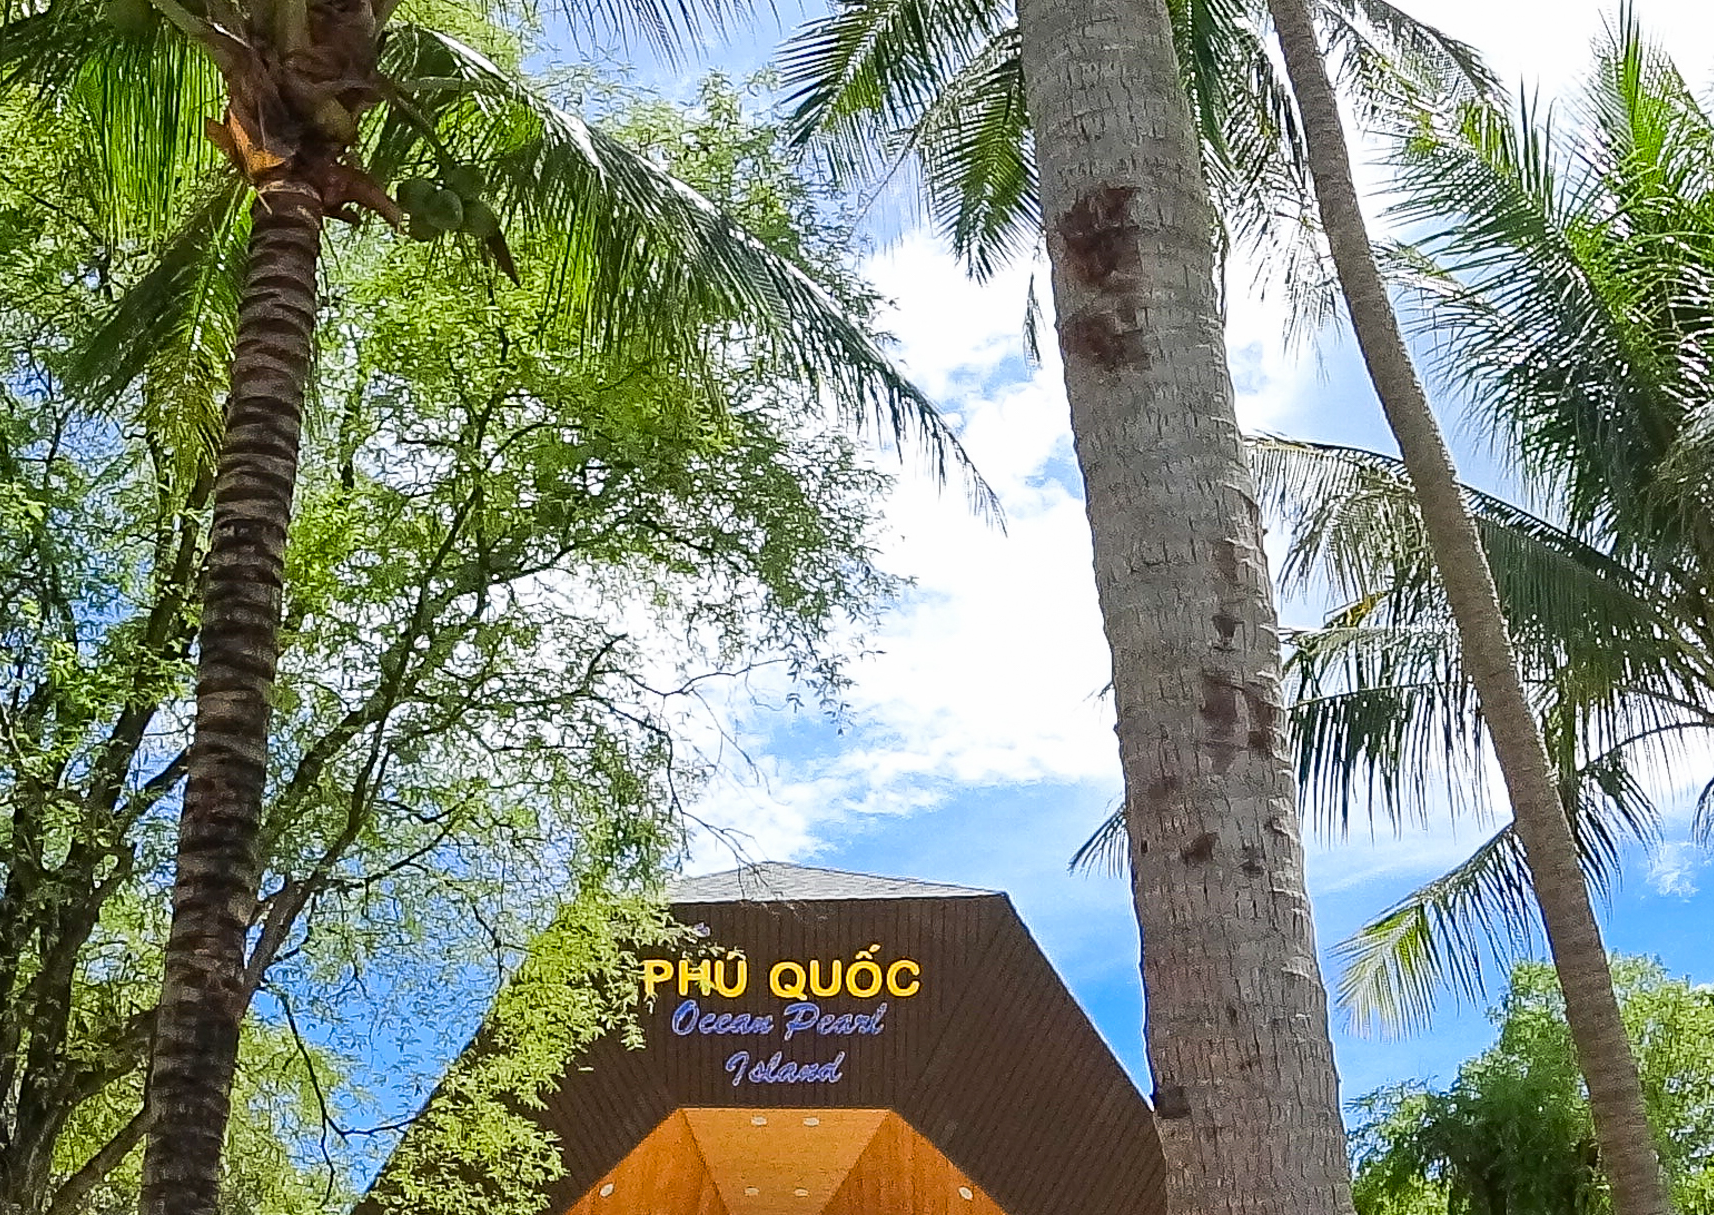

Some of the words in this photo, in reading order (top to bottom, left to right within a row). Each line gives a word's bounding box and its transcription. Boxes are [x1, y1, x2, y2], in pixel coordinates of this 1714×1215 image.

[769, 943, 921, 1000] QUỐC
[672, 1000, 774, 1035] Ocean
[785, 1001, 888, 1040] Pearl
[725, 1050, 845, 1086] Island
